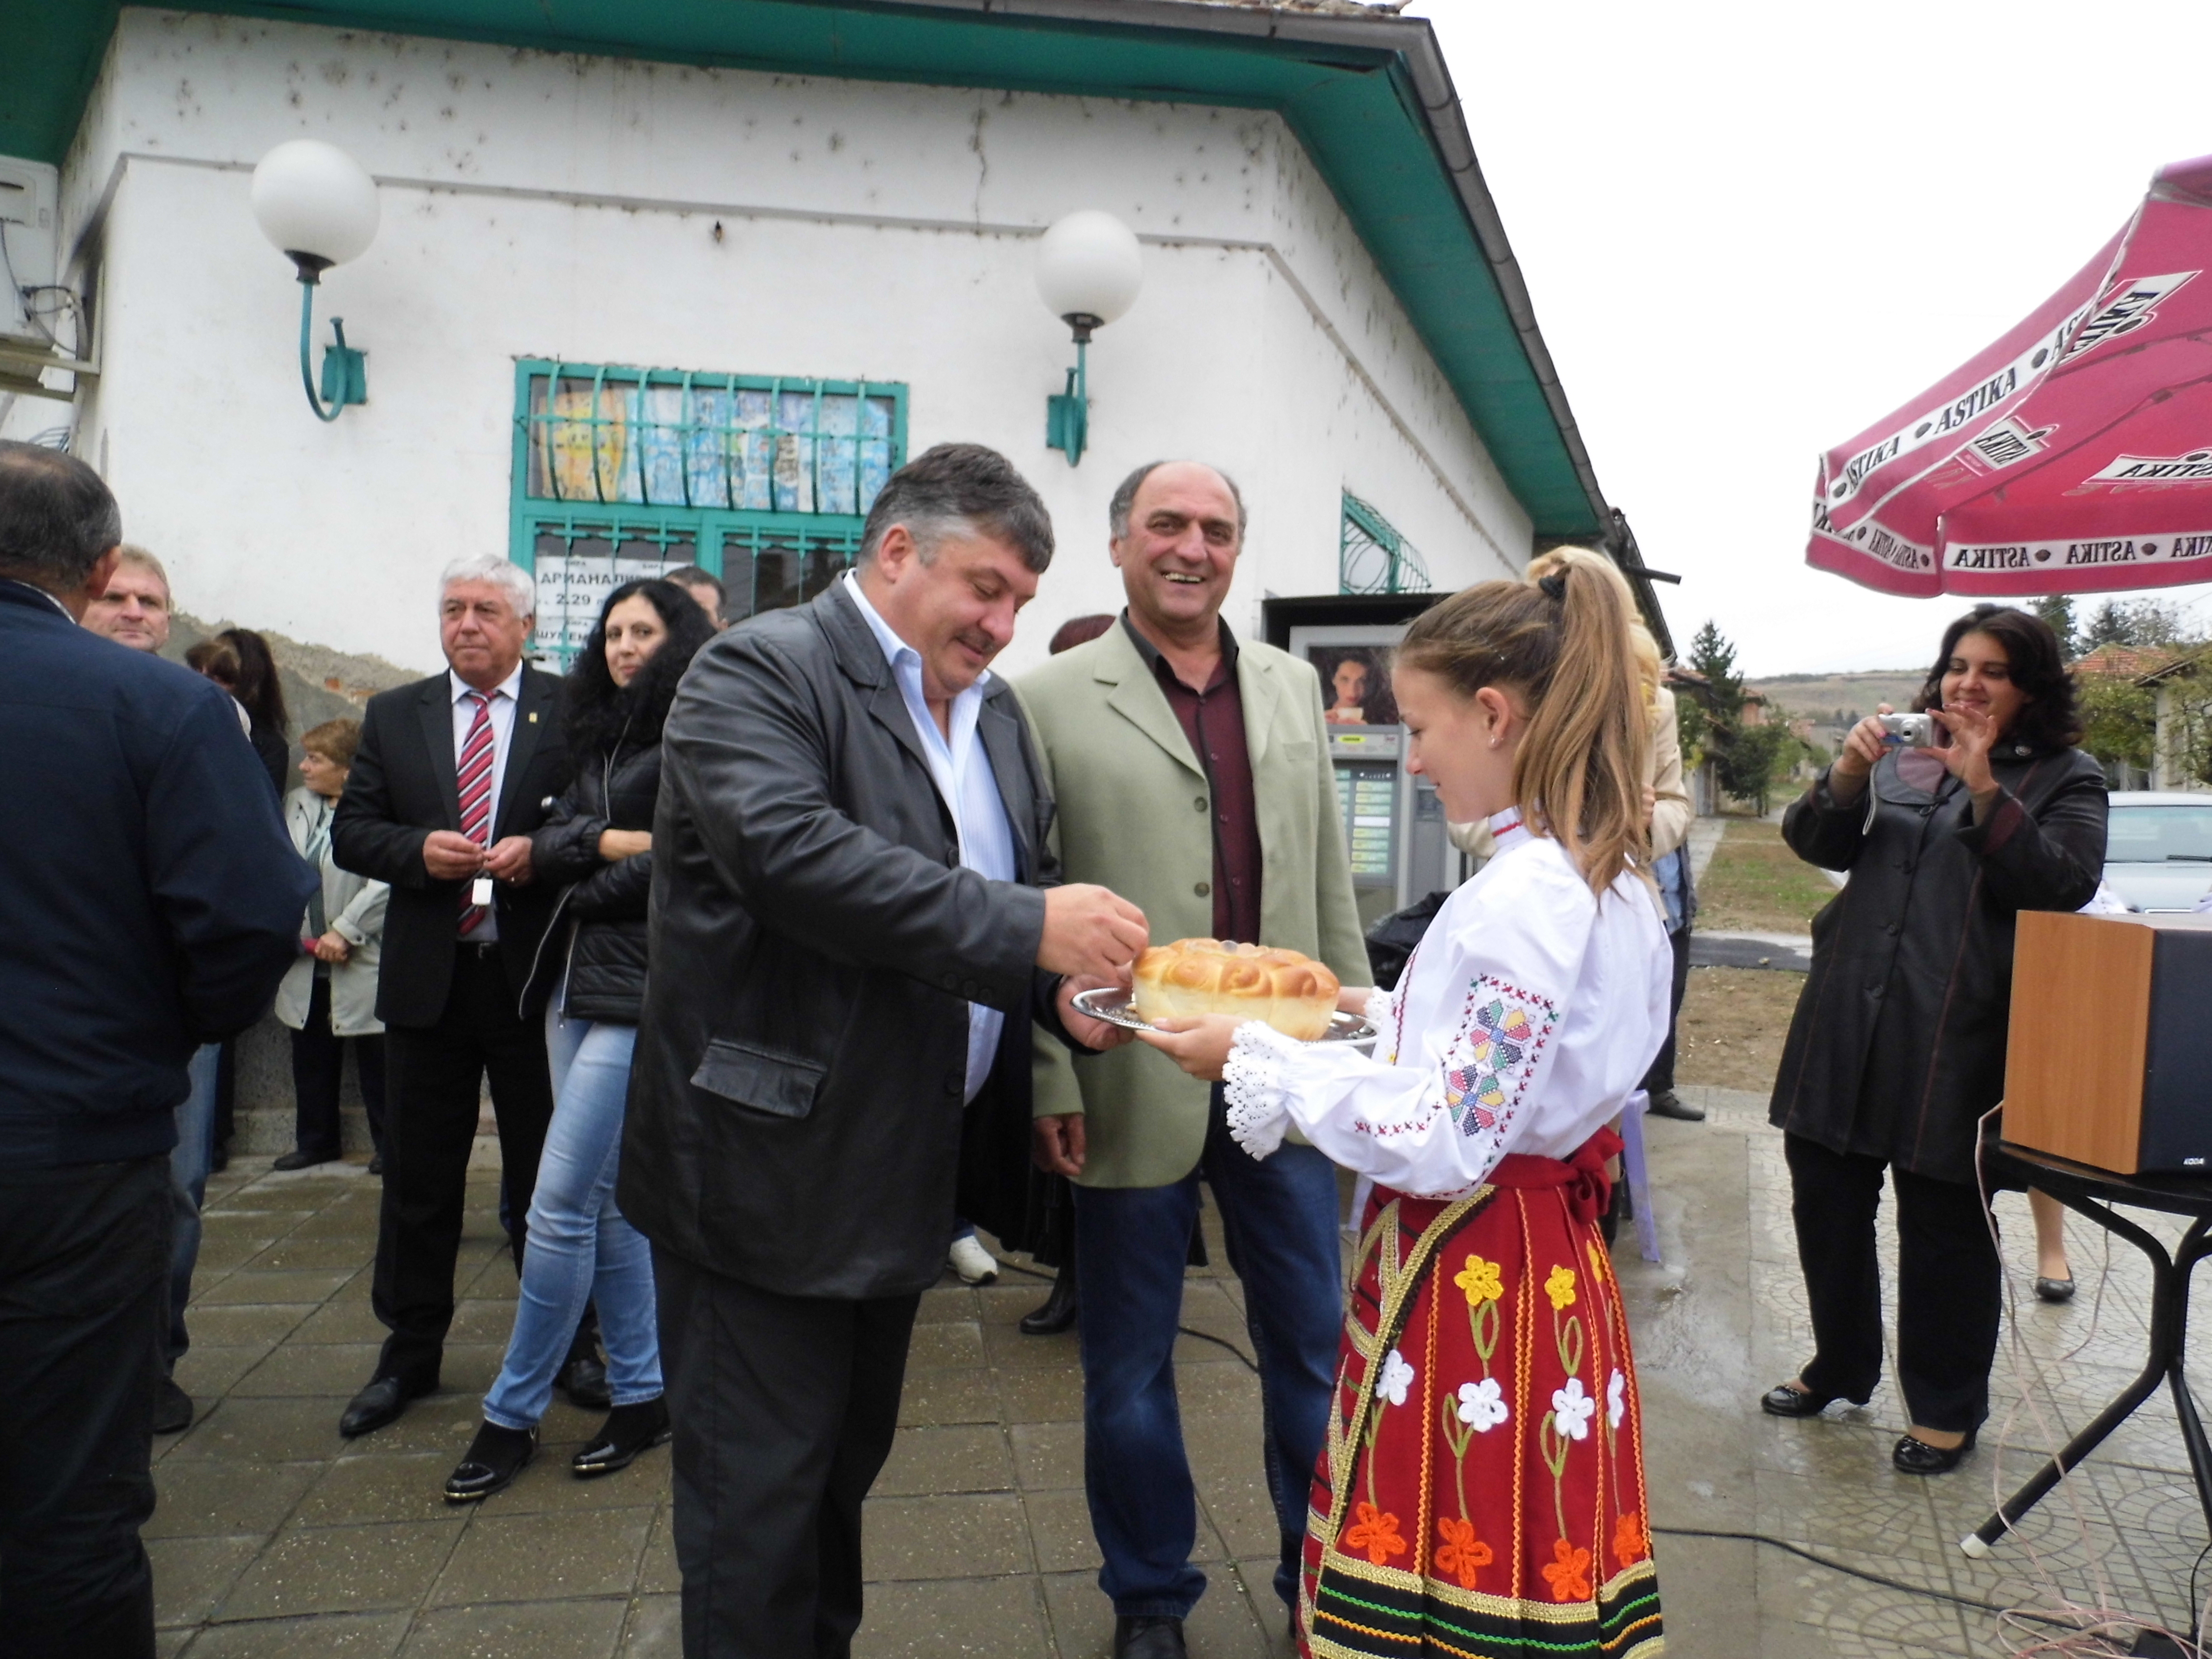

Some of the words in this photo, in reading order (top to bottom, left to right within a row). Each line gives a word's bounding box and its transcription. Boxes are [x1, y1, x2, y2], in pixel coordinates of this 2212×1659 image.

[1934, 366, 2016, 435] ASTIKA
[1846, 436, 1899, 494] ASTIKA
[541, 573, 612, 585] АРИАНА
[556, 593, 590, 605] 2.29
